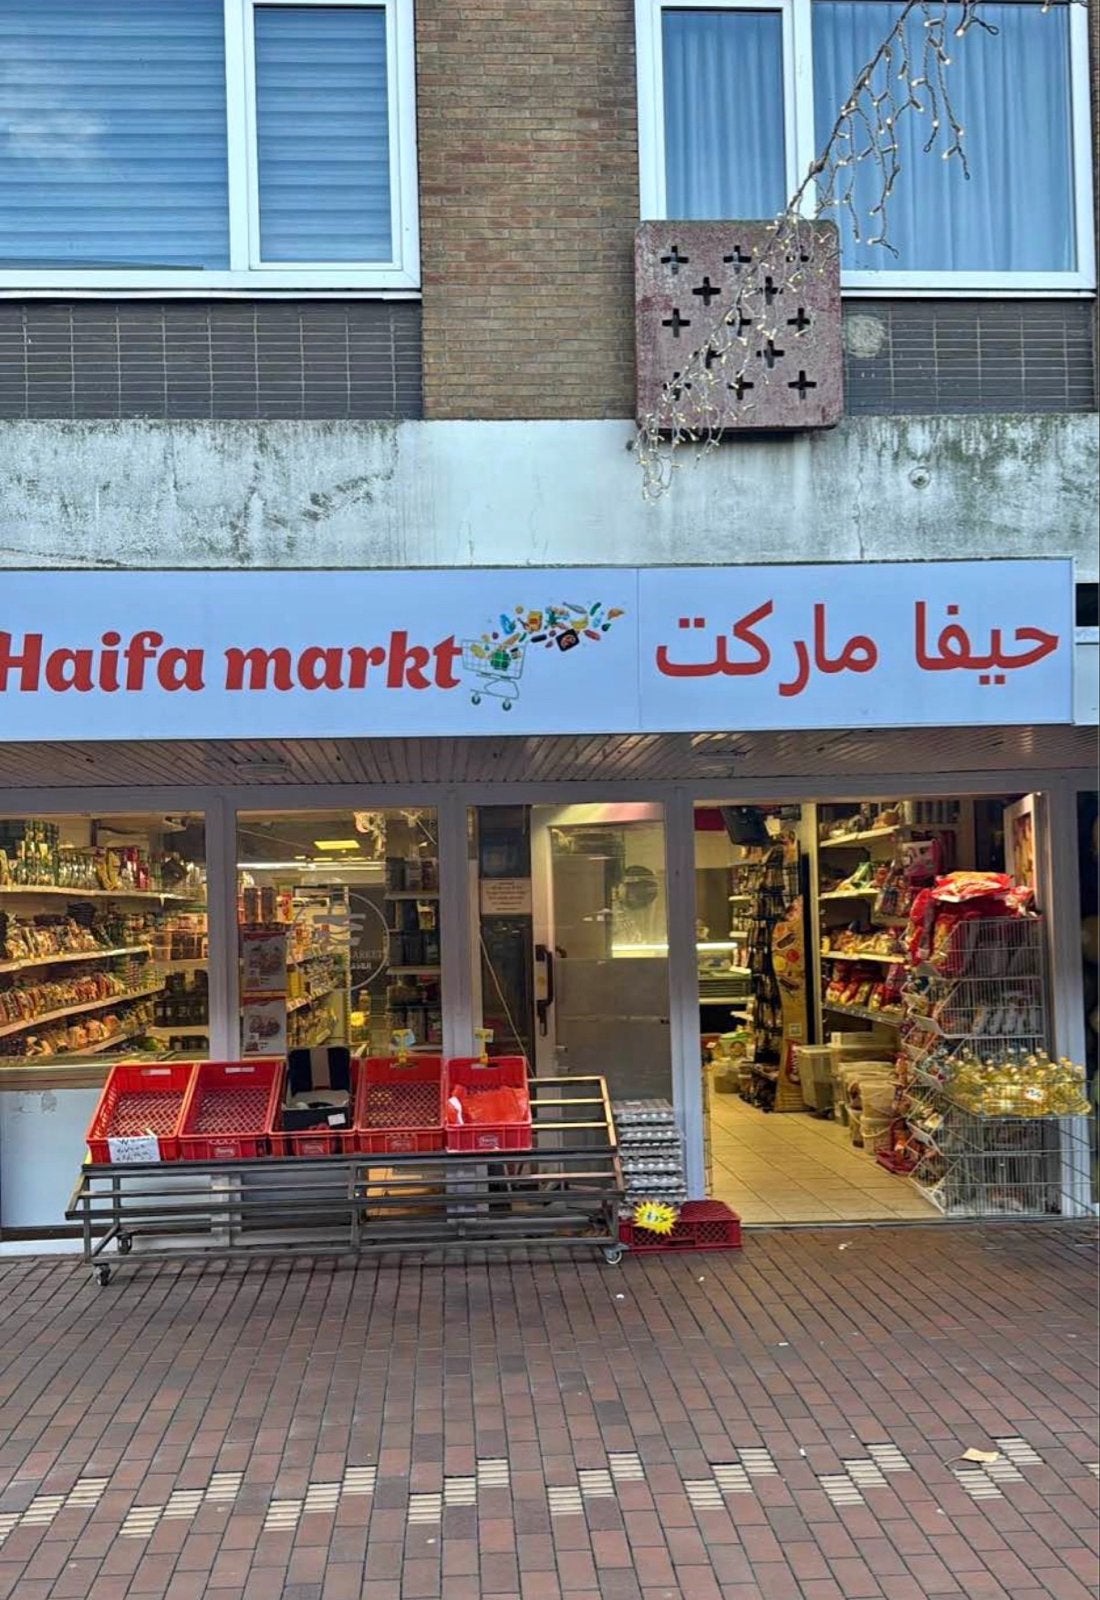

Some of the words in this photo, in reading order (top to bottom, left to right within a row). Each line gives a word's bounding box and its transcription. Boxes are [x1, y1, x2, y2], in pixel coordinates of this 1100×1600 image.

[0, 630, 205, 692] Haifa
[225, 630, 463, 691] markt
[655, 599, 879, 697] ماركت
[915, 600, 1060, 685] حيفا
